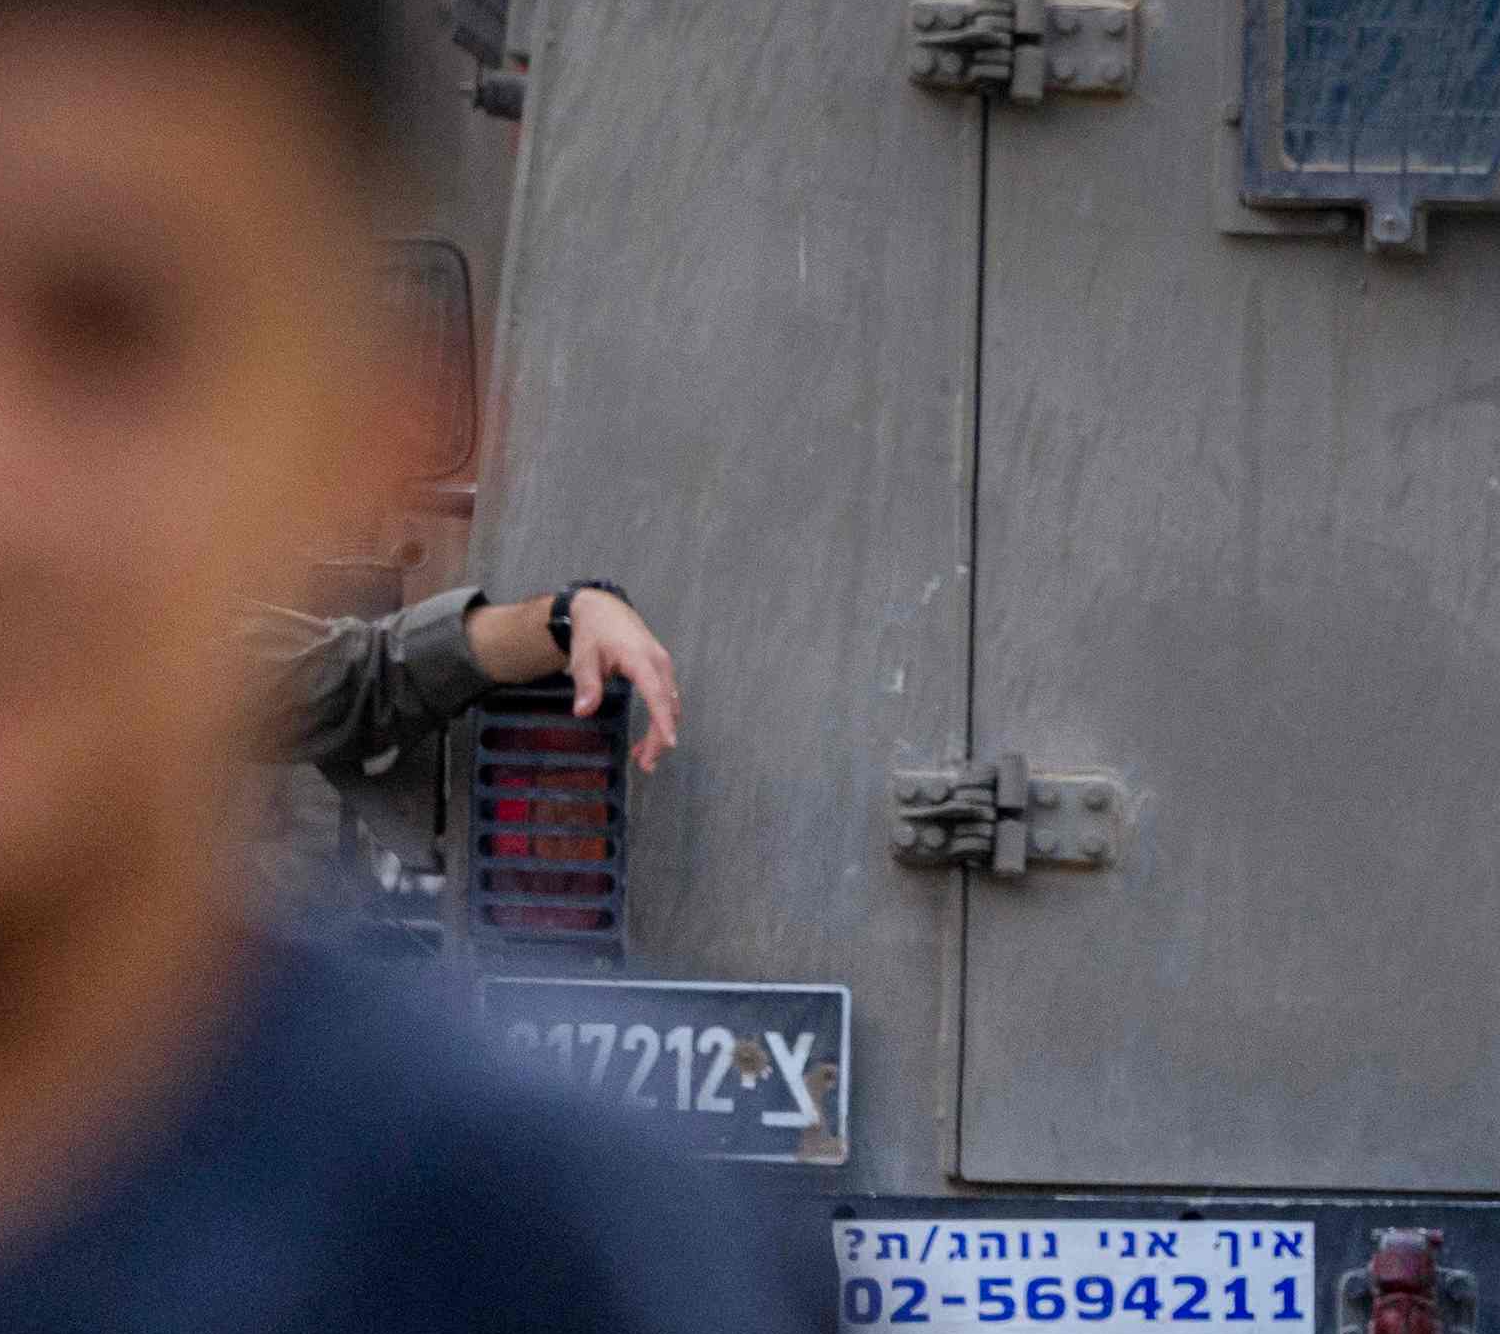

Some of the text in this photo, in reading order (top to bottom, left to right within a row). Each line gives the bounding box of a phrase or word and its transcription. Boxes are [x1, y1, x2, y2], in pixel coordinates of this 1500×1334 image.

[844, 1225, 1304, 1268] איך אני נוהג/ת?
[843, 1274, 1305, 1325] 02-5694211
